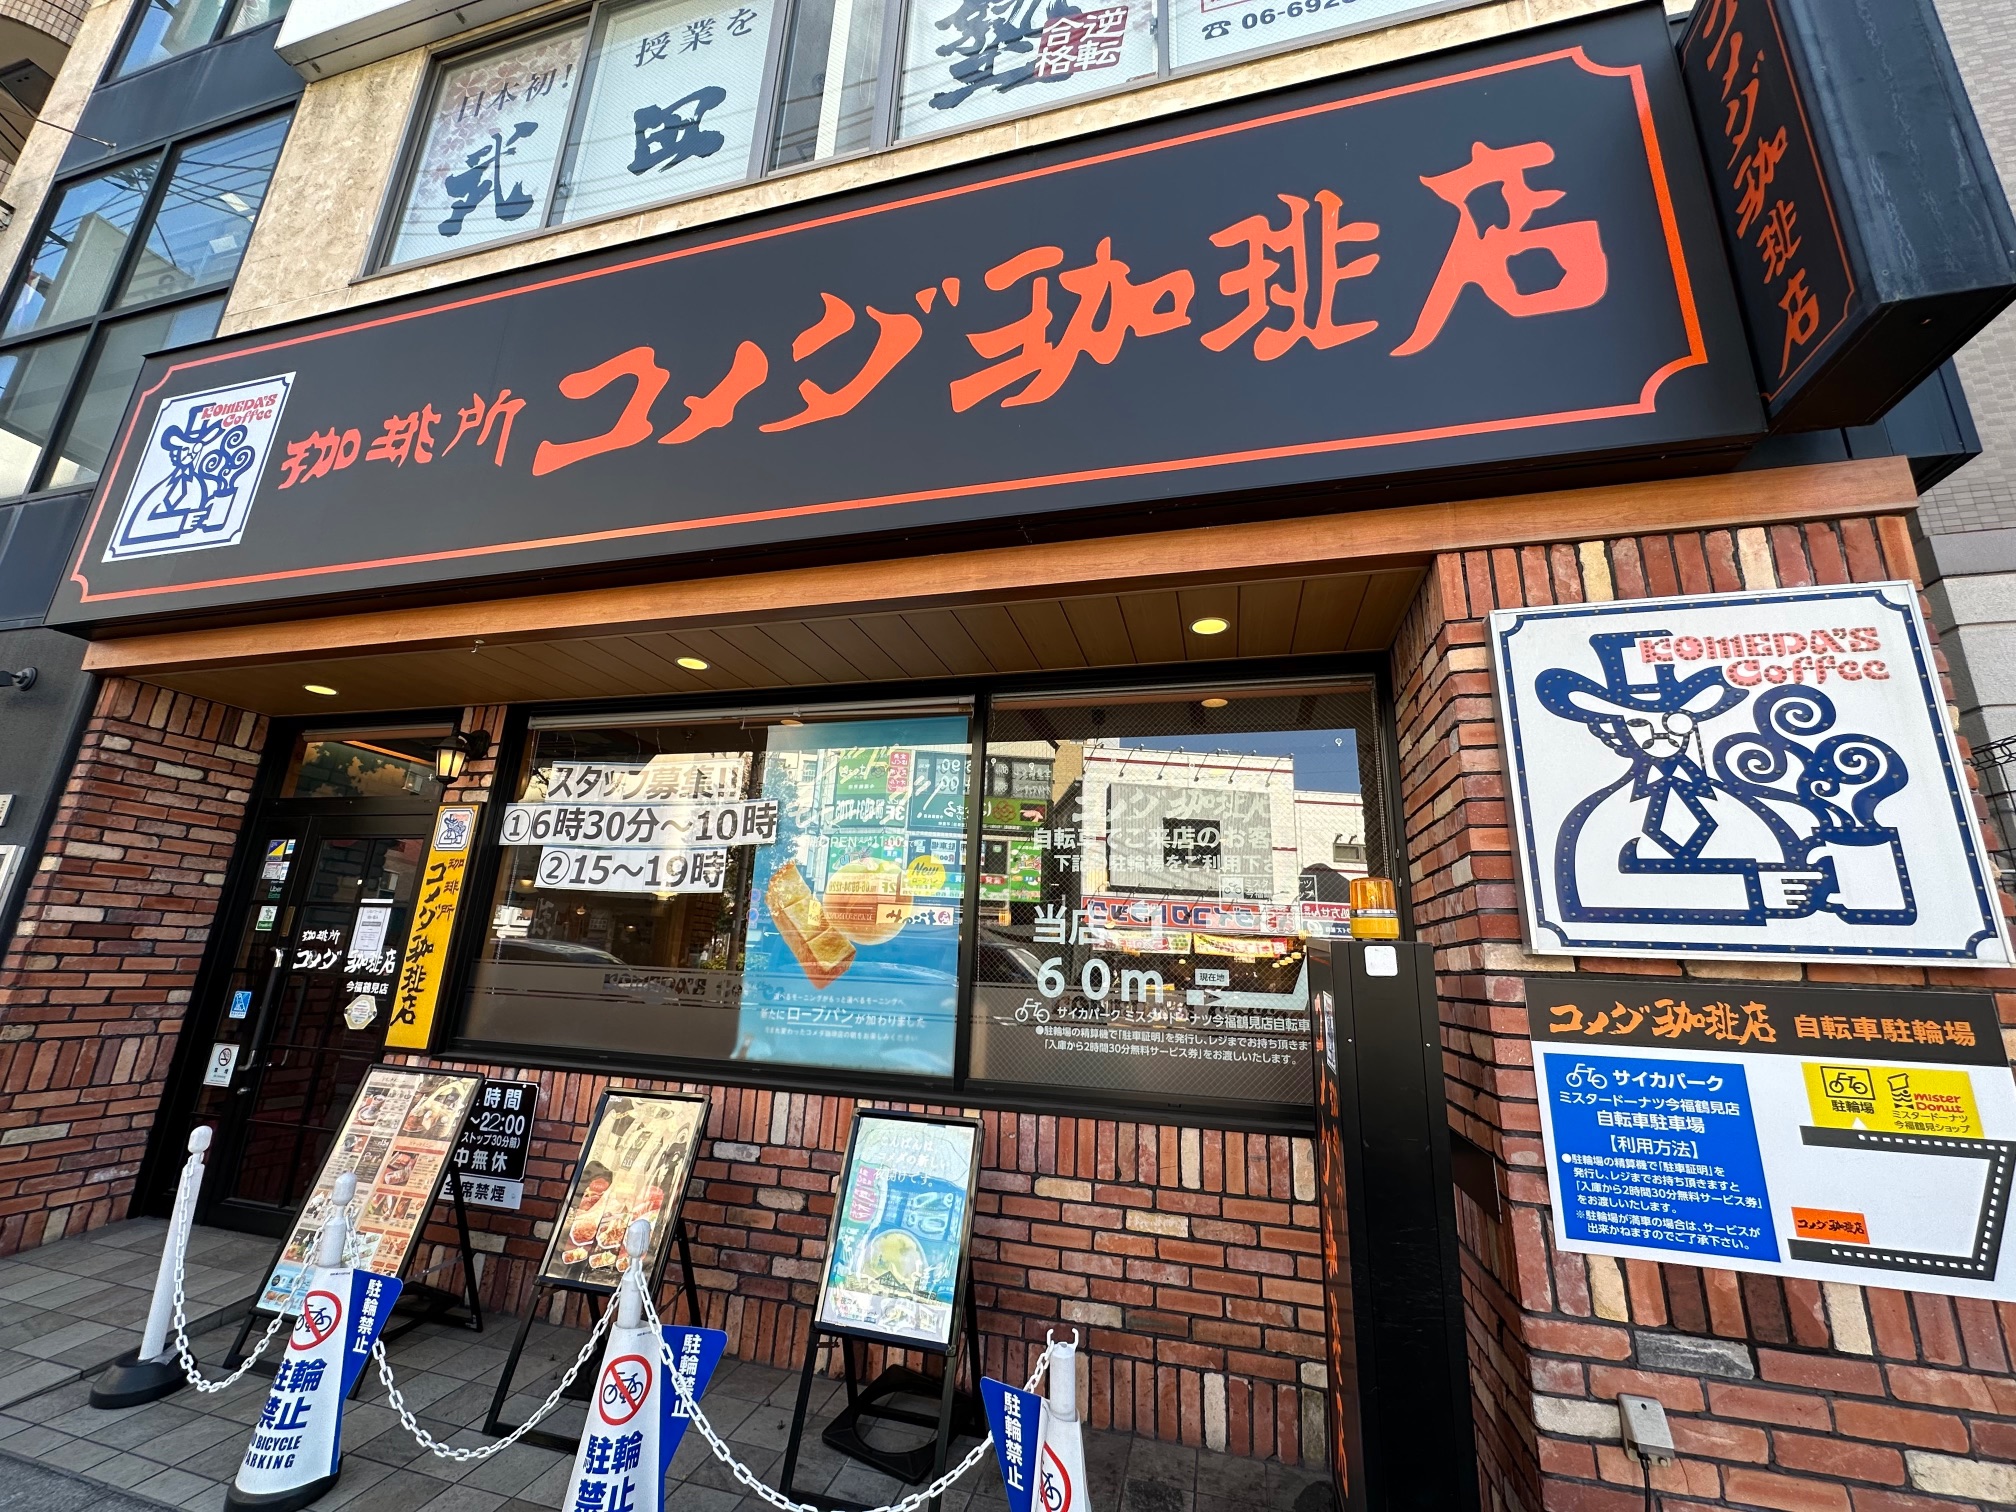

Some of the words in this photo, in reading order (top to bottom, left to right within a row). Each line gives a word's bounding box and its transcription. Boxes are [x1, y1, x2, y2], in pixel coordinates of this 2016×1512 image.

[626, 86, 727, 175] 田
[279, 388, 527, 490] 珈琲所
[532, 140, 1609, 475] コメダ珈琲店
[201, 393, 278, 419] KOMEDA'S
[222, 409, 273, 428] Coffee
[1639, 626, 1882, 663] KOMEDA'S
[1724, 655, 1890, 687] Coffee
[911, 862, 939, 877] New
[390, 862, 447, 1026] コメダ珈琲店
[346, 980, 390, 995] 今福鶴見店
[1199, 972, 1225, 982] 現在地
[1549, 998, 1777, 1046] コメダ珈琲店
[1793, 1014, 1976, 1047] 自転車駐輪場
[1612, 1069, 1724, 1092] サイカパーク
[1559, 1090, 1740, 1117] ミスタードーナツ今福鶴見店
[1831, 1099, 1875, 1114] 駐輪場
[1892, 1110, 1969, 1123] ミスタードーナツ
[1915, 1101, 1965, 1114] Donut
[1596, 1110, 1706, 1134] 自転車駐車場
[1894, 1120, 1971, 1134] 今福鶴見ショップ
[1609, 1134, 1699, 1160] 【利用方法】
[1573, 1166, 1740, 1192] 発行し、レジまでお持ち頂きますと
[1576, 1194, 1678, 1214] をお渡しいたします。
[1587, 1222, 1751, 1250] 出来かねますのでご了承下さい。
[352, 1279, 383, 1355] 駐輪禁止
[256, 1435, 303, 1452] BICYCLE
[583, 1430, 644, 1475] 駐輪
[1003, 1391, 1025, 1491] 駐輪禁止
[245, 1450, 296, 1470] ARKING
